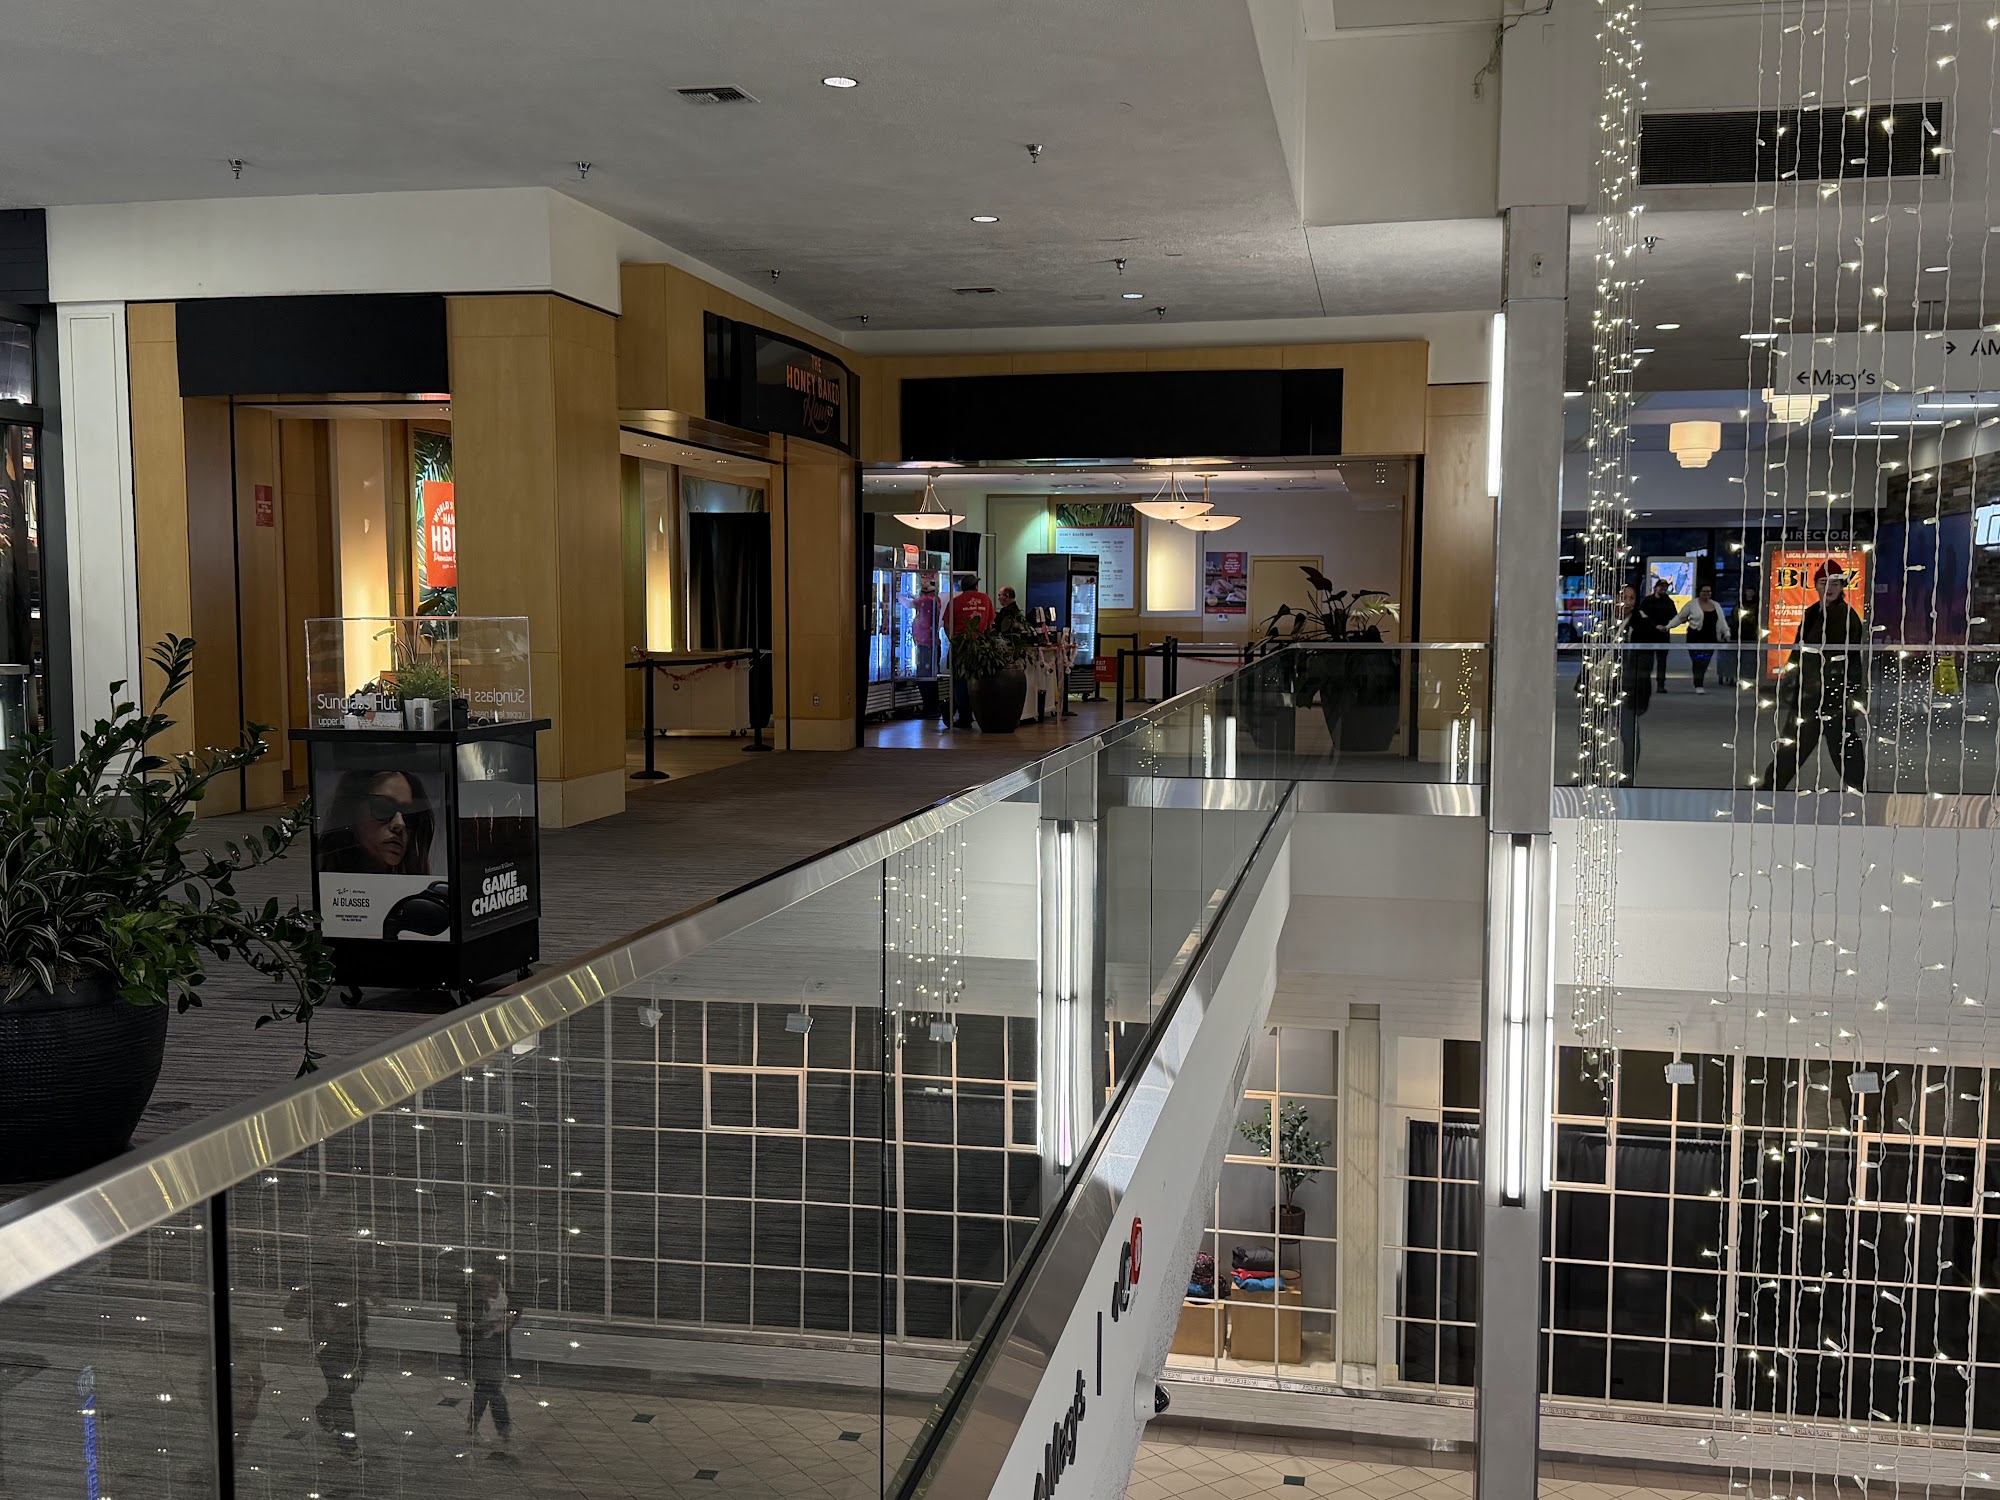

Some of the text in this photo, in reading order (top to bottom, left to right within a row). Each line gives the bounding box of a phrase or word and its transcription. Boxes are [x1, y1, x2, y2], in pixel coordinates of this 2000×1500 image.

[811, 354, 822, 373] THE
[787, 365, 840, 405] HONEY BAKED
[1813, 369, 1875, 389] Macy's
[1775, 567, 1861, 590] BUZ
[317, 694, 397, 713] Sunglass Hut
[318, 717, 338, 726] upper
[482, 870, 517, 895] GAME
[333, 898, 370, 907] AI GLASSES
[471, 885, 528, 917] CHANGER
